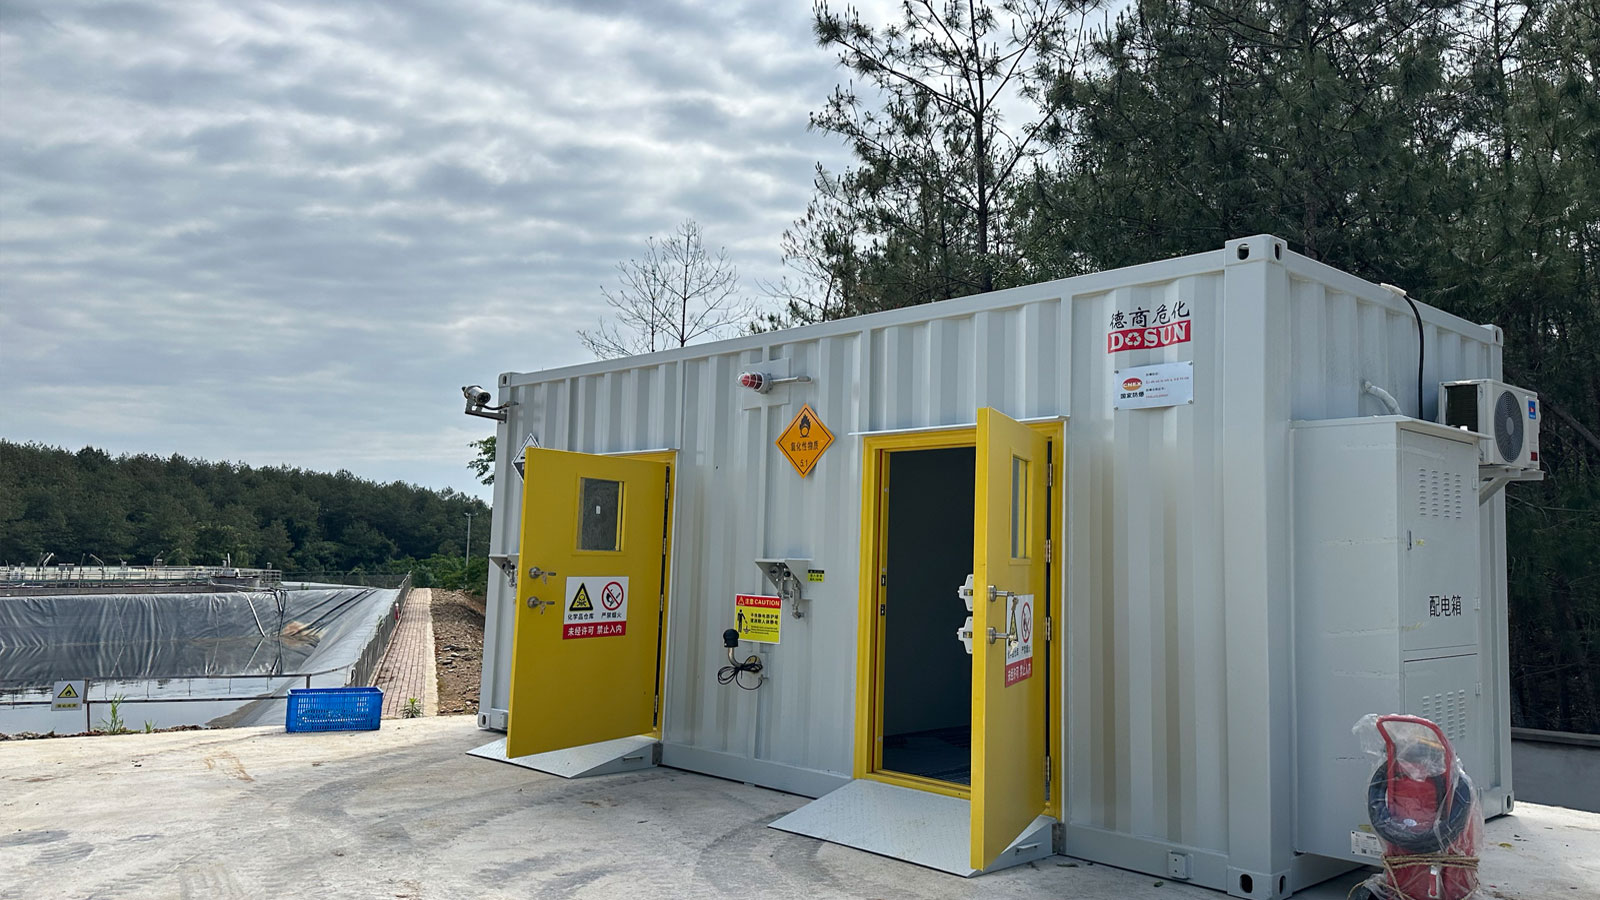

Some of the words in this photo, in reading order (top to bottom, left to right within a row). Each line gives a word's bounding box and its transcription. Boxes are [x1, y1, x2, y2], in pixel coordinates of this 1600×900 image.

[1109, 301, 1190, 329] 德商危化
[790, 440, 819, 452] 氧化性物质
[754, 598, 780, 607] CAUTION
[1429, 594, 1462, 618] 配电箱
[567, 612, 595, 621] 化学品仓库
[601, 611, 622, 619] 严禁烟火
[567, 625, 595, 636] 未经许可
[596, 624, 622, 635] 禁止入内
